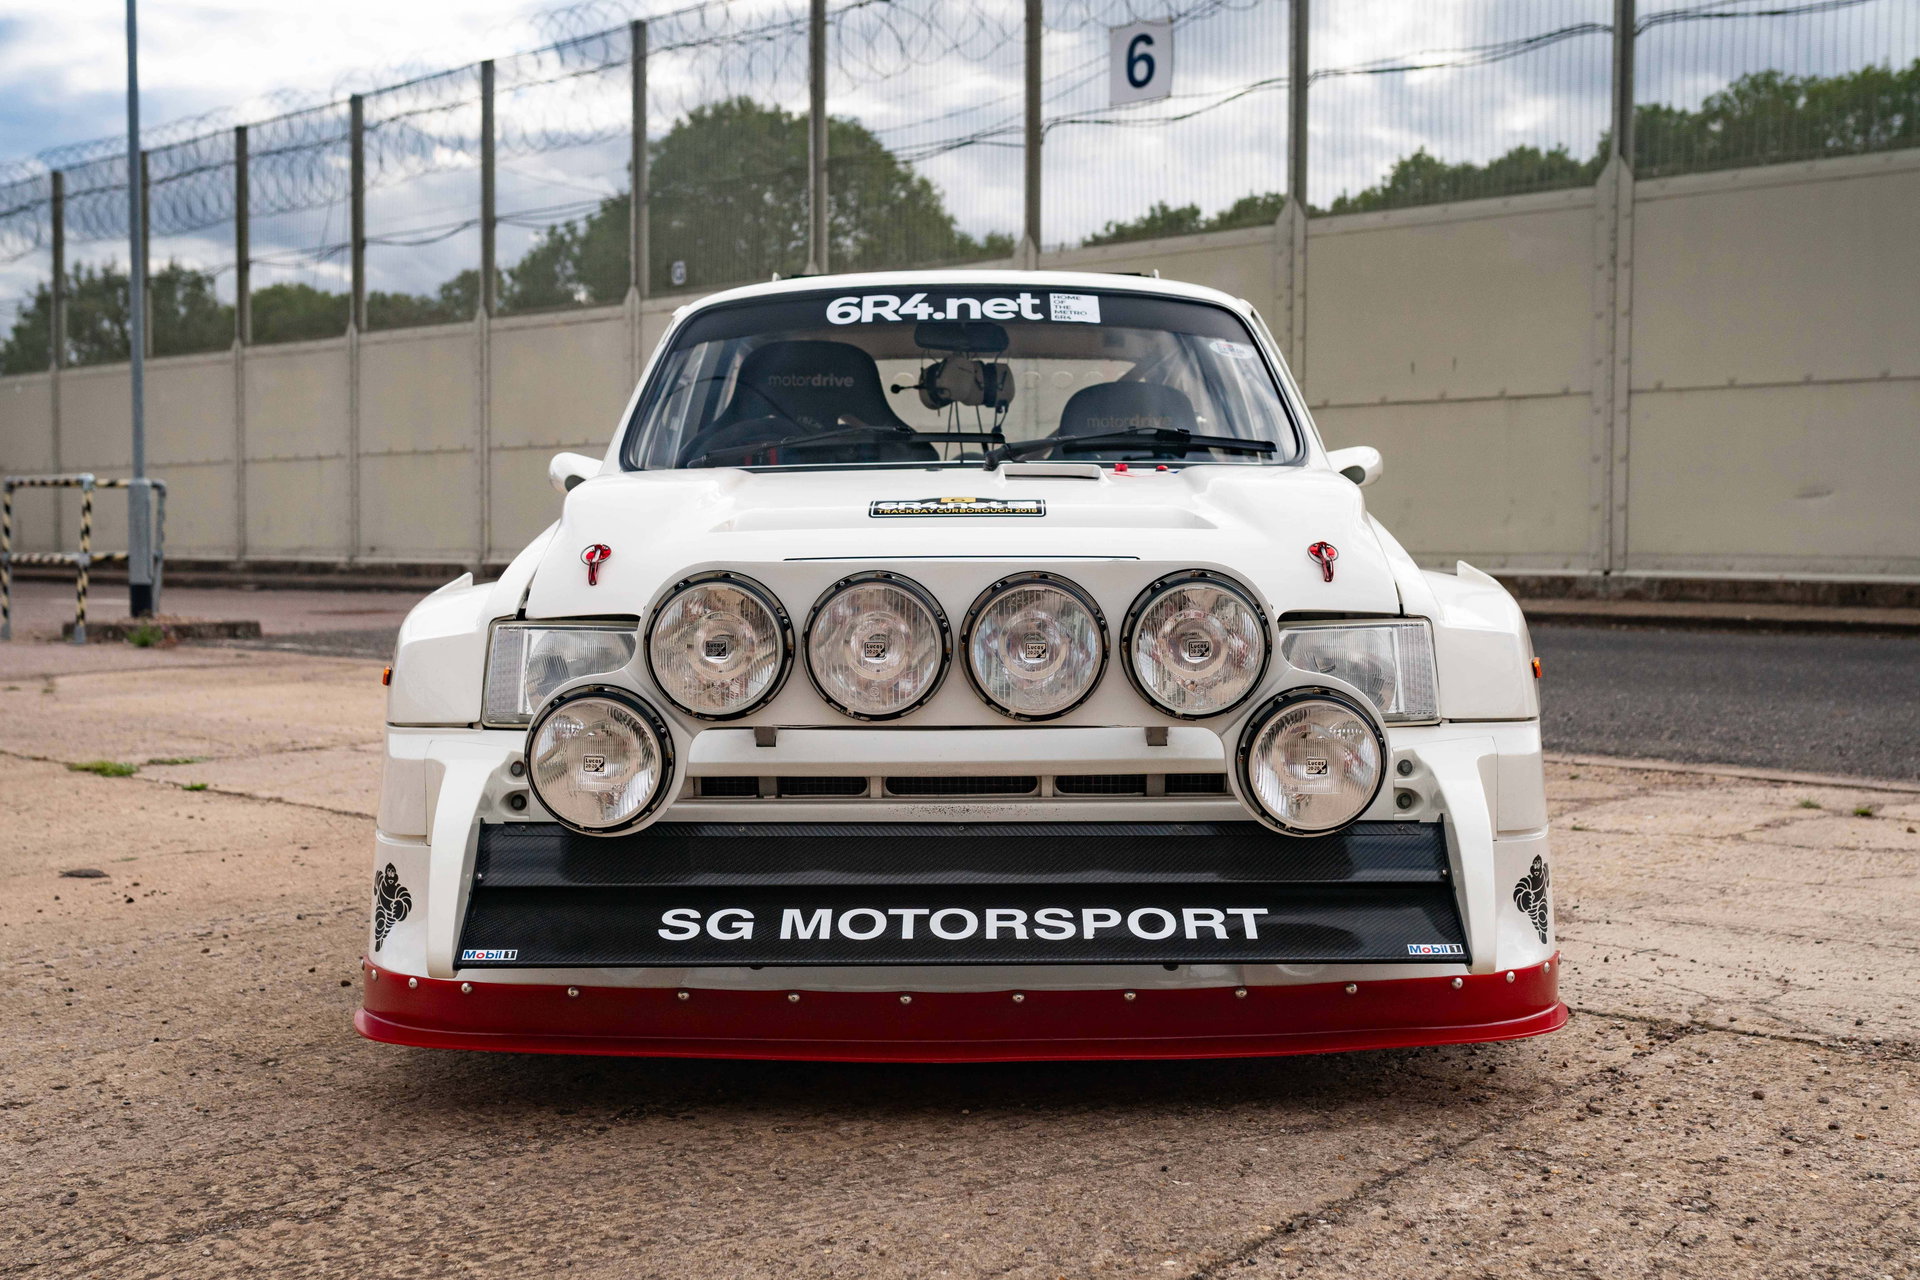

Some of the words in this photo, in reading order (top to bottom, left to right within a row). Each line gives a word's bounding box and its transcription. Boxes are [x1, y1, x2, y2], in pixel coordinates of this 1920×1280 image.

[1126, 32, 1155, 88] 6
[826, 292, 1044, 325] 6R4.net
[768, 373, 855, 387] motordrive
[657, 907, 754, 941] SG
[779, 907, 1269, 941] MOTORSPORT
[464, 951, 503, 959] Mobil
[1409, 945, 1448, 953] Mobil
